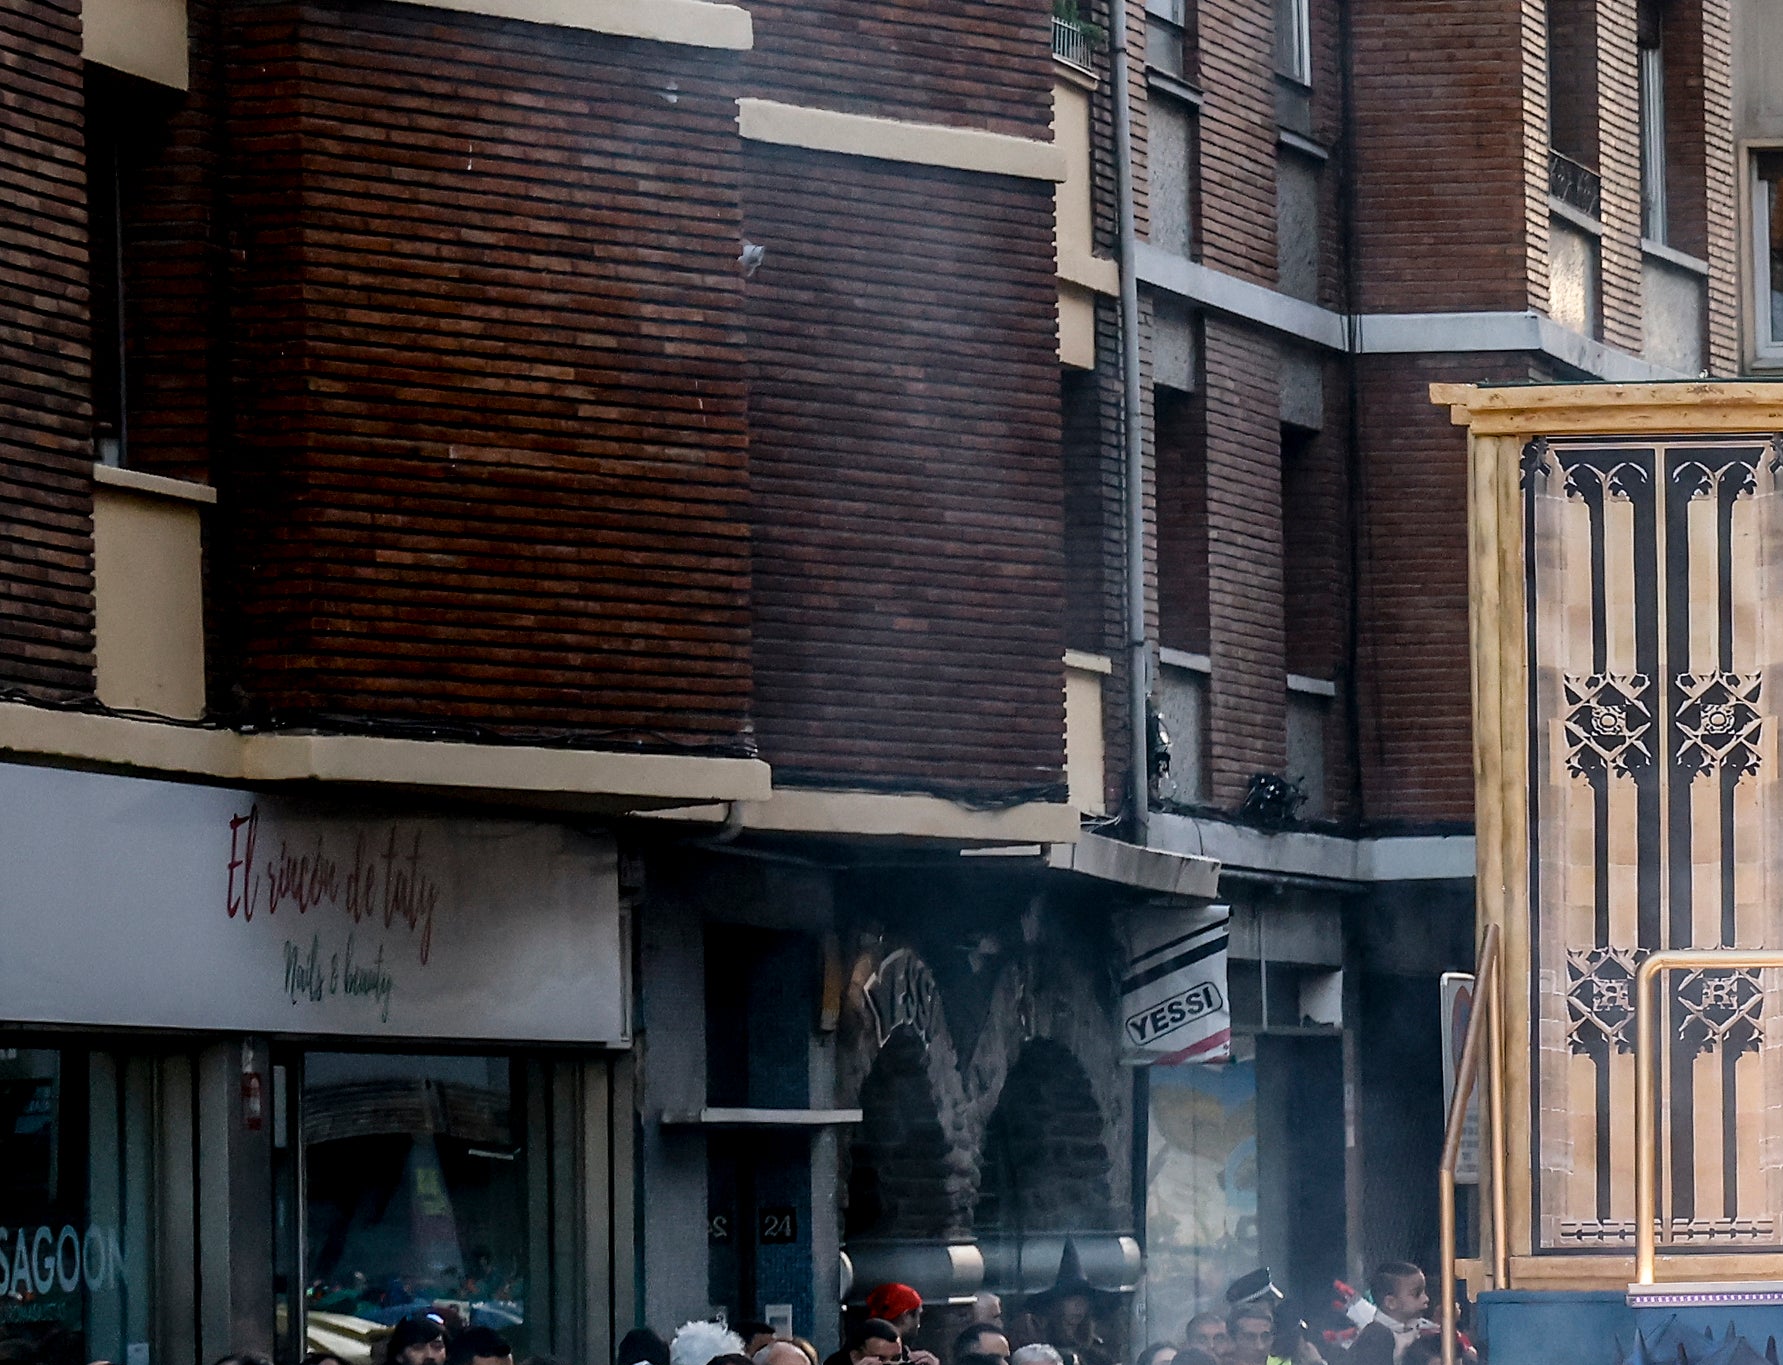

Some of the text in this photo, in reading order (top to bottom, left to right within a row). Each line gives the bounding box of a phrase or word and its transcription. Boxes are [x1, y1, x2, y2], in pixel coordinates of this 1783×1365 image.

[227, 803, 259, 922] El
[346, 832, 375, 924] de
[381, 825, 438, 966] taty
[284, 934, 323, 1004] Nails
[1129, 986, 1213, 1040] YESSI
[764, 1214, 791, 1237] 24
